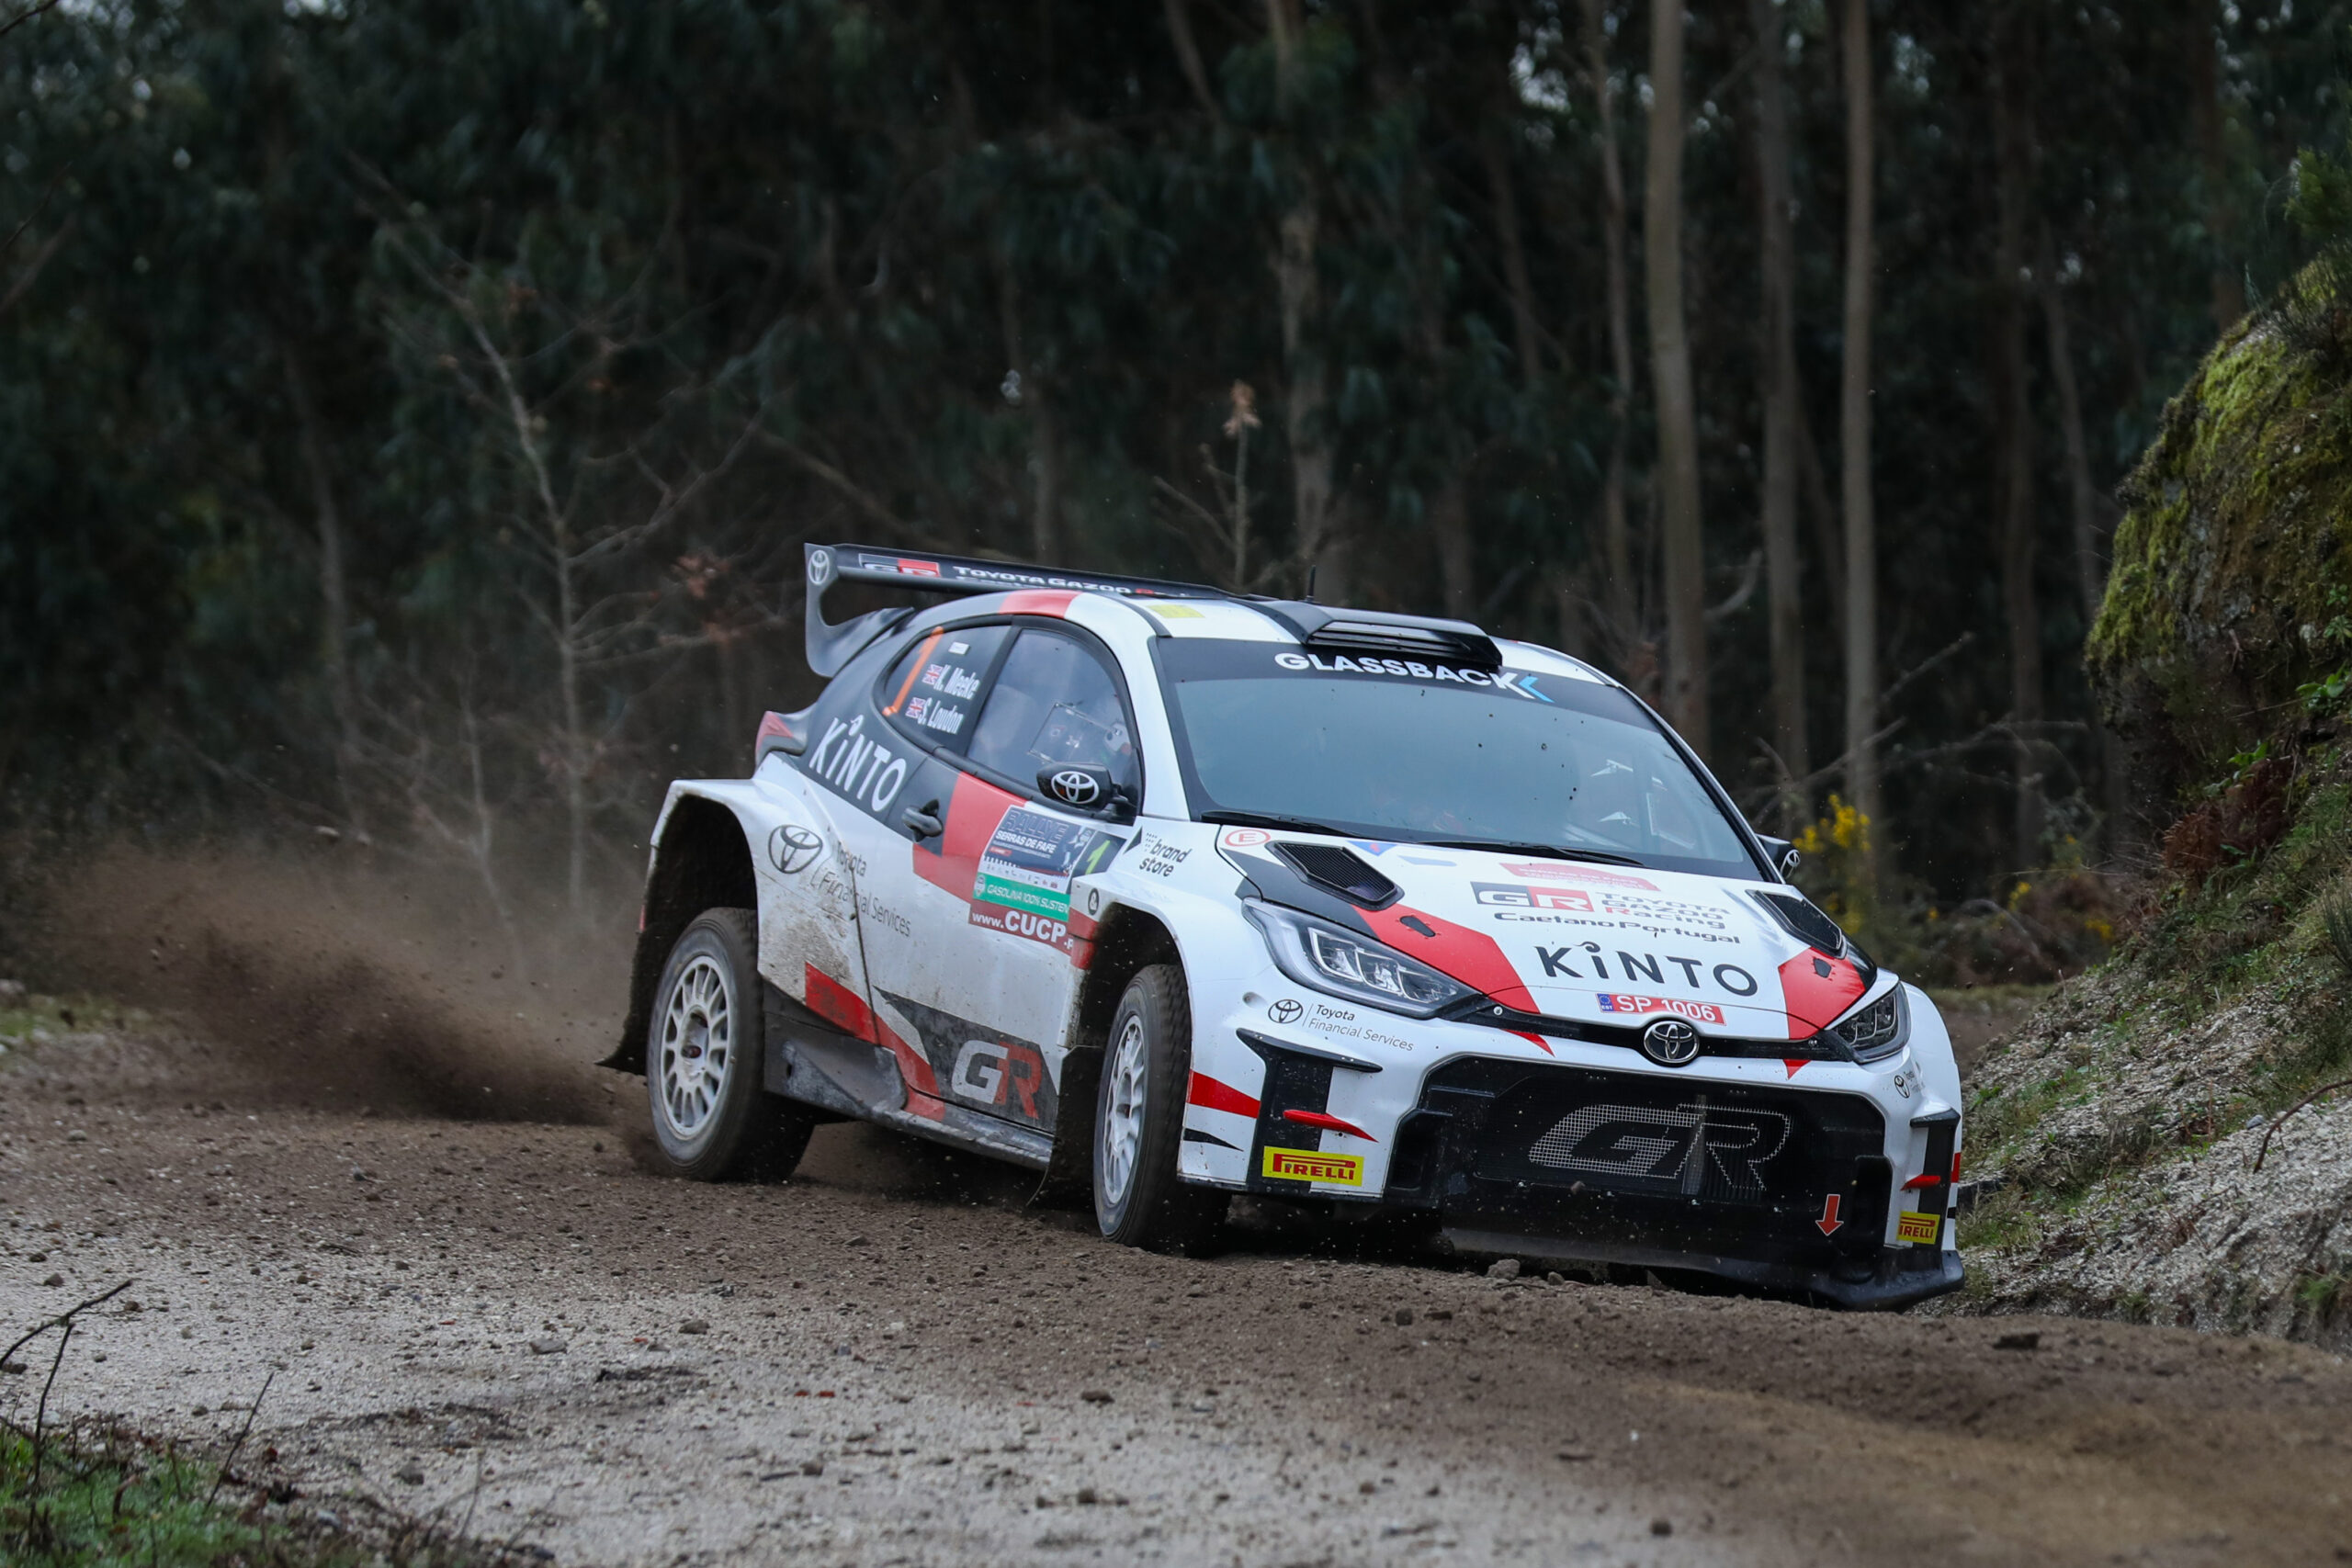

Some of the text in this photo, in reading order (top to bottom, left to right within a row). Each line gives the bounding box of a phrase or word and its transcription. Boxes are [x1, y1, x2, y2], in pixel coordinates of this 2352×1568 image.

[953, 566, 1045, 584] TOYOTA
[1048, 578, 1131, 593] GAZOO
[1273, 652, 1536, 699] GLASSBACK
[1150, 840, 1193, 863] brand
[1139, 857, 1174, 877] store
[1478, 890, 1588, 910] GR
[1596, 892, 1730, 915] TOYOTA
[1601, 899, 1724, 919] GAZOO
[871, 897, 910, 937] Services
[1495, 913, 1741, 943] Caetano Portugal
[1605, 908, 1725, 930] Racing
[1316, 1004, 1355, 1021] Toyota
[1617, 996, 1715, 1021] SP 1006
[1308, 1018, 1414, 1051] Financial Services
[951, 1040, 1042, 1120] GR
[1529, 1103, 1793, 1190] GR
[1272, 1153, 1356, 1179] PIRELLI
